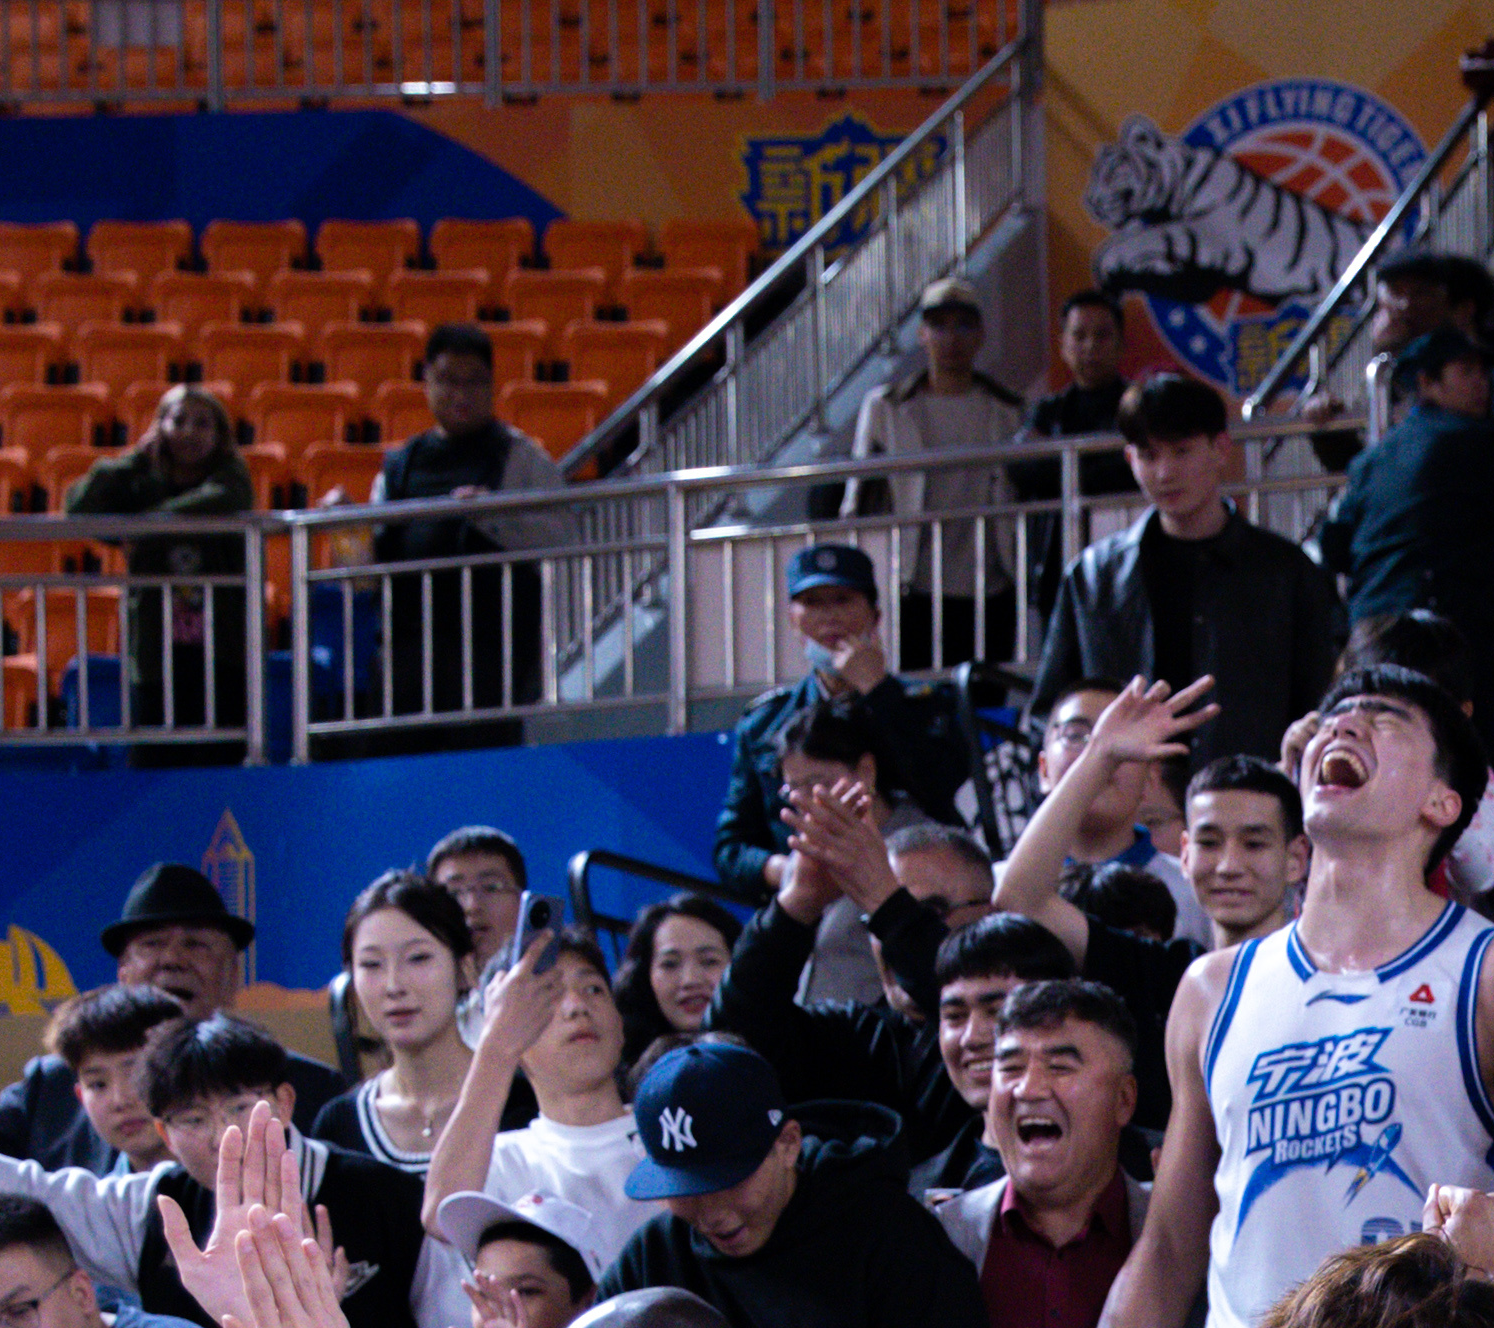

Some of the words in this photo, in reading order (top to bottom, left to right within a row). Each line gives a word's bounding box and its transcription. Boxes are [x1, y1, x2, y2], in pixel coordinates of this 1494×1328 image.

[1248, 1030, 1386, 1098] 宁波
[1248, 1078, 1393, 1150] NINGBO
[1273, 1124, 1359, 1166] ROCKETS
